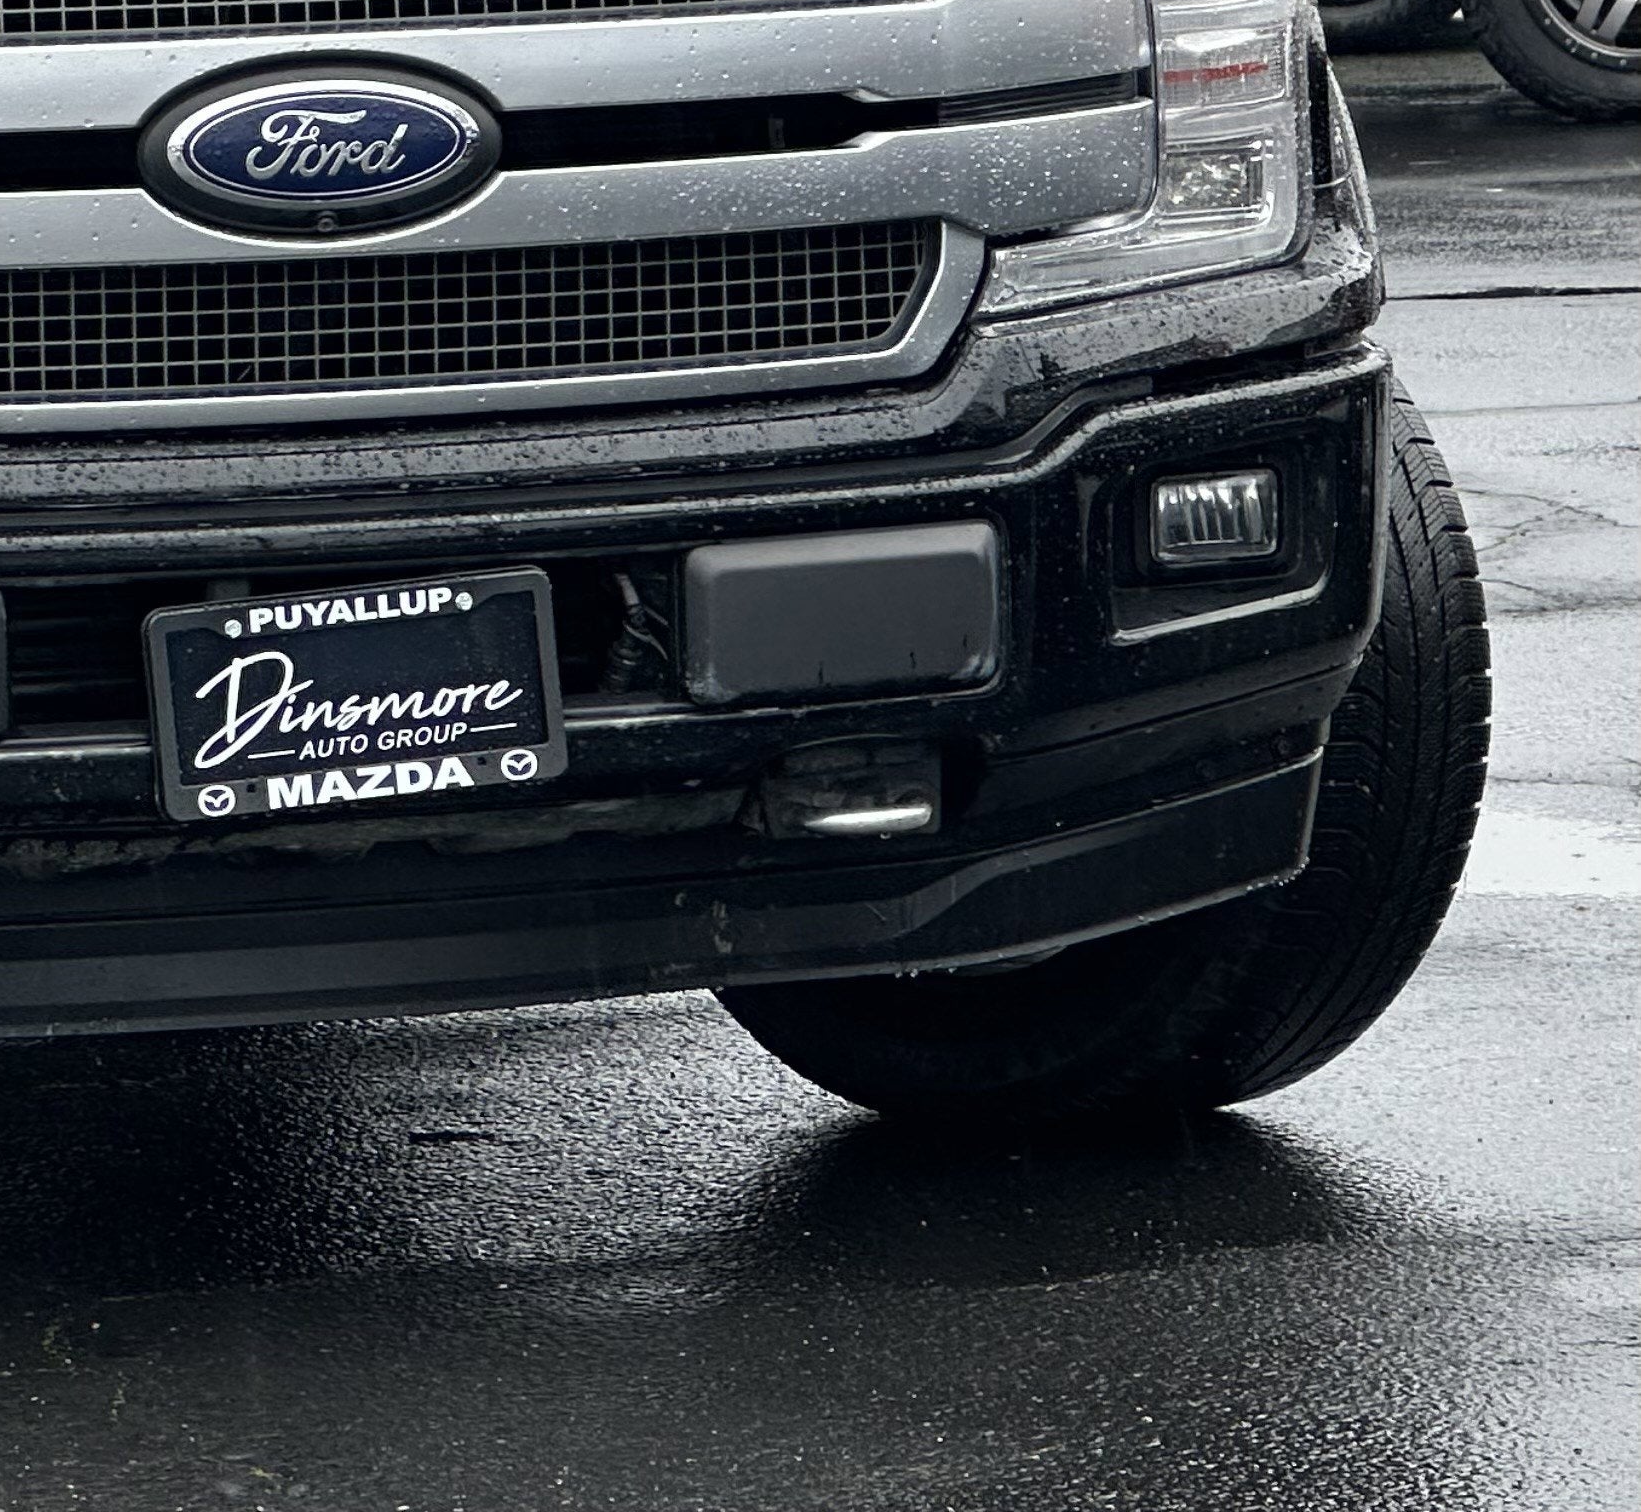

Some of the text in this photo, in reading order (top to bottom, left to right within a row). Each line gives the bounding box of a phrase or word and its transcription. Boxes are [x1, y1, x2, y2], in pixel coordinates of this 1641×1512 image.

[245, 109, 409, 180] Ford
[248, 588, 453, 634] PUYALLUP
[194, 651, 524, 769] Dinsmore
[299, 721, 468, 761] AUTO GROUP
[266, 756, 475, 810] MAZDA
